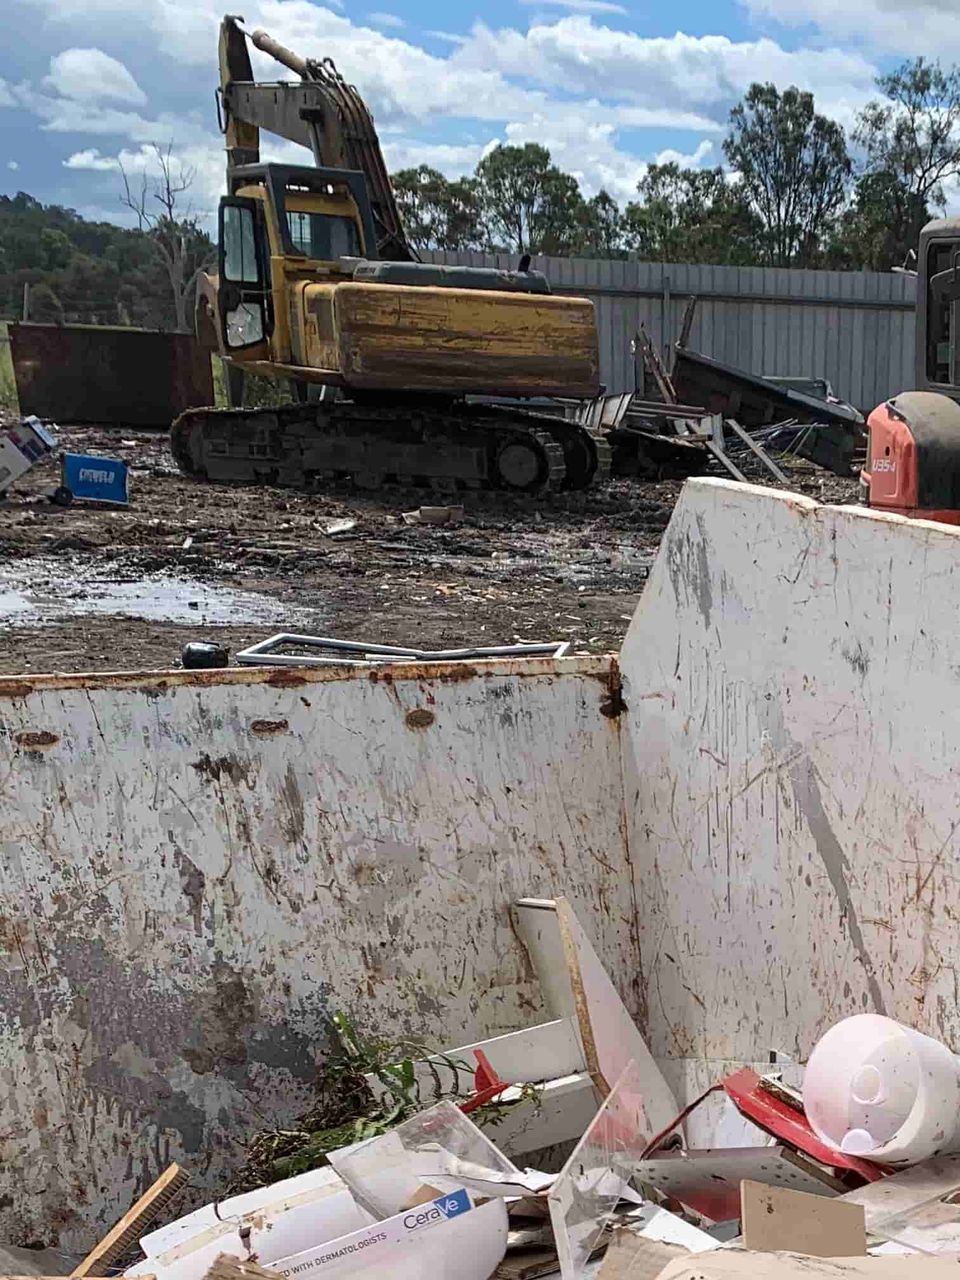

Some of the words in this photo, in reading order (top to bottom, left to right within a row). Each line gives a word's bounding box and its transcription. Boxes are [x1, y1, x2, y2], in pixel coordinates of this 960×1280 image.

[403, 1197, 460, 1230] CeraVe
[291, 1262, 315, 1275] WITH
[314, 1232, 388, 1267] DERMATOLOGISTS
